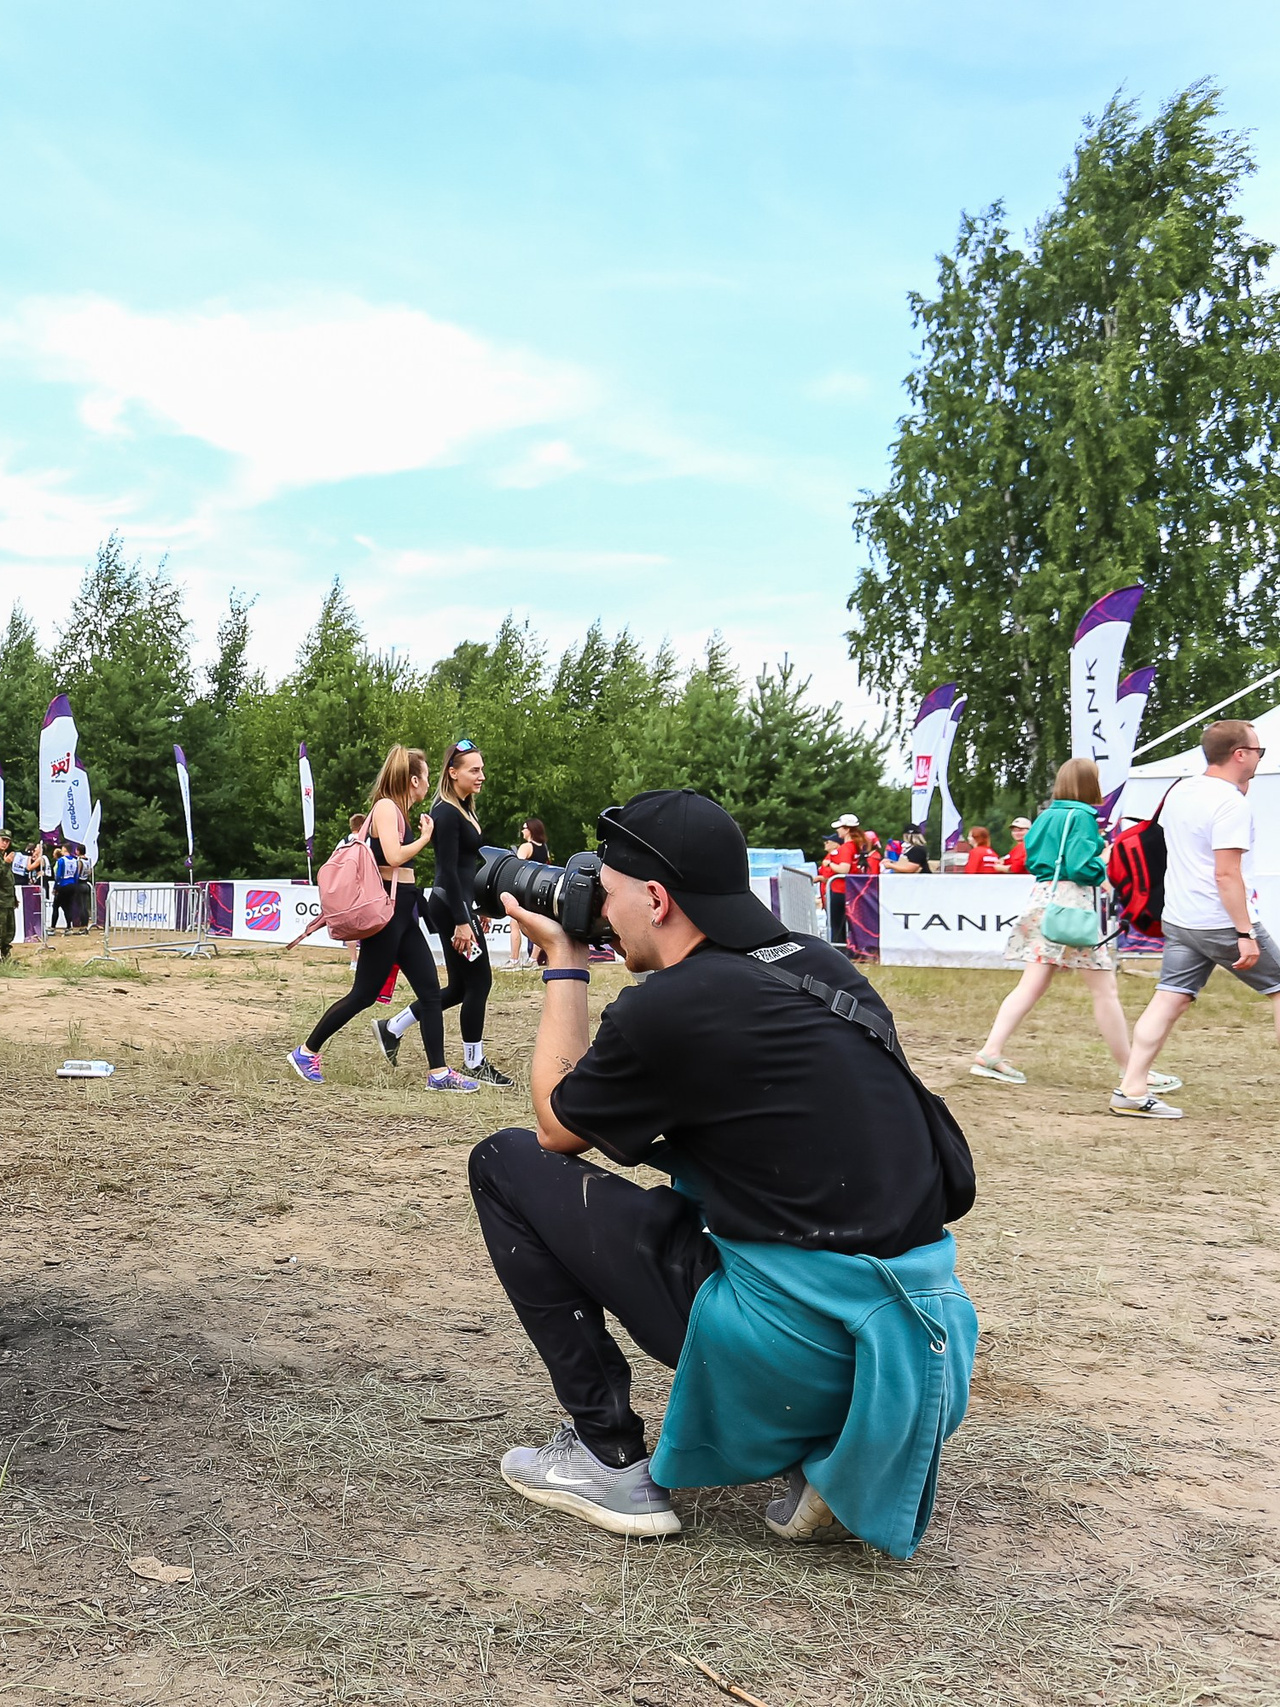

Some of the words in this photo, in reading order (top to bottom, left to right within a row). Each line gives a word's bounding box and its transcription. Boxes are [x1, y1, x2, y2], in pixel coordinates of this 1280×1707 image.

[1086, 658, 1109, 762] TANK
[246, 904, 281, 918] OZON
[893, 913, 1019, 931] TANK
